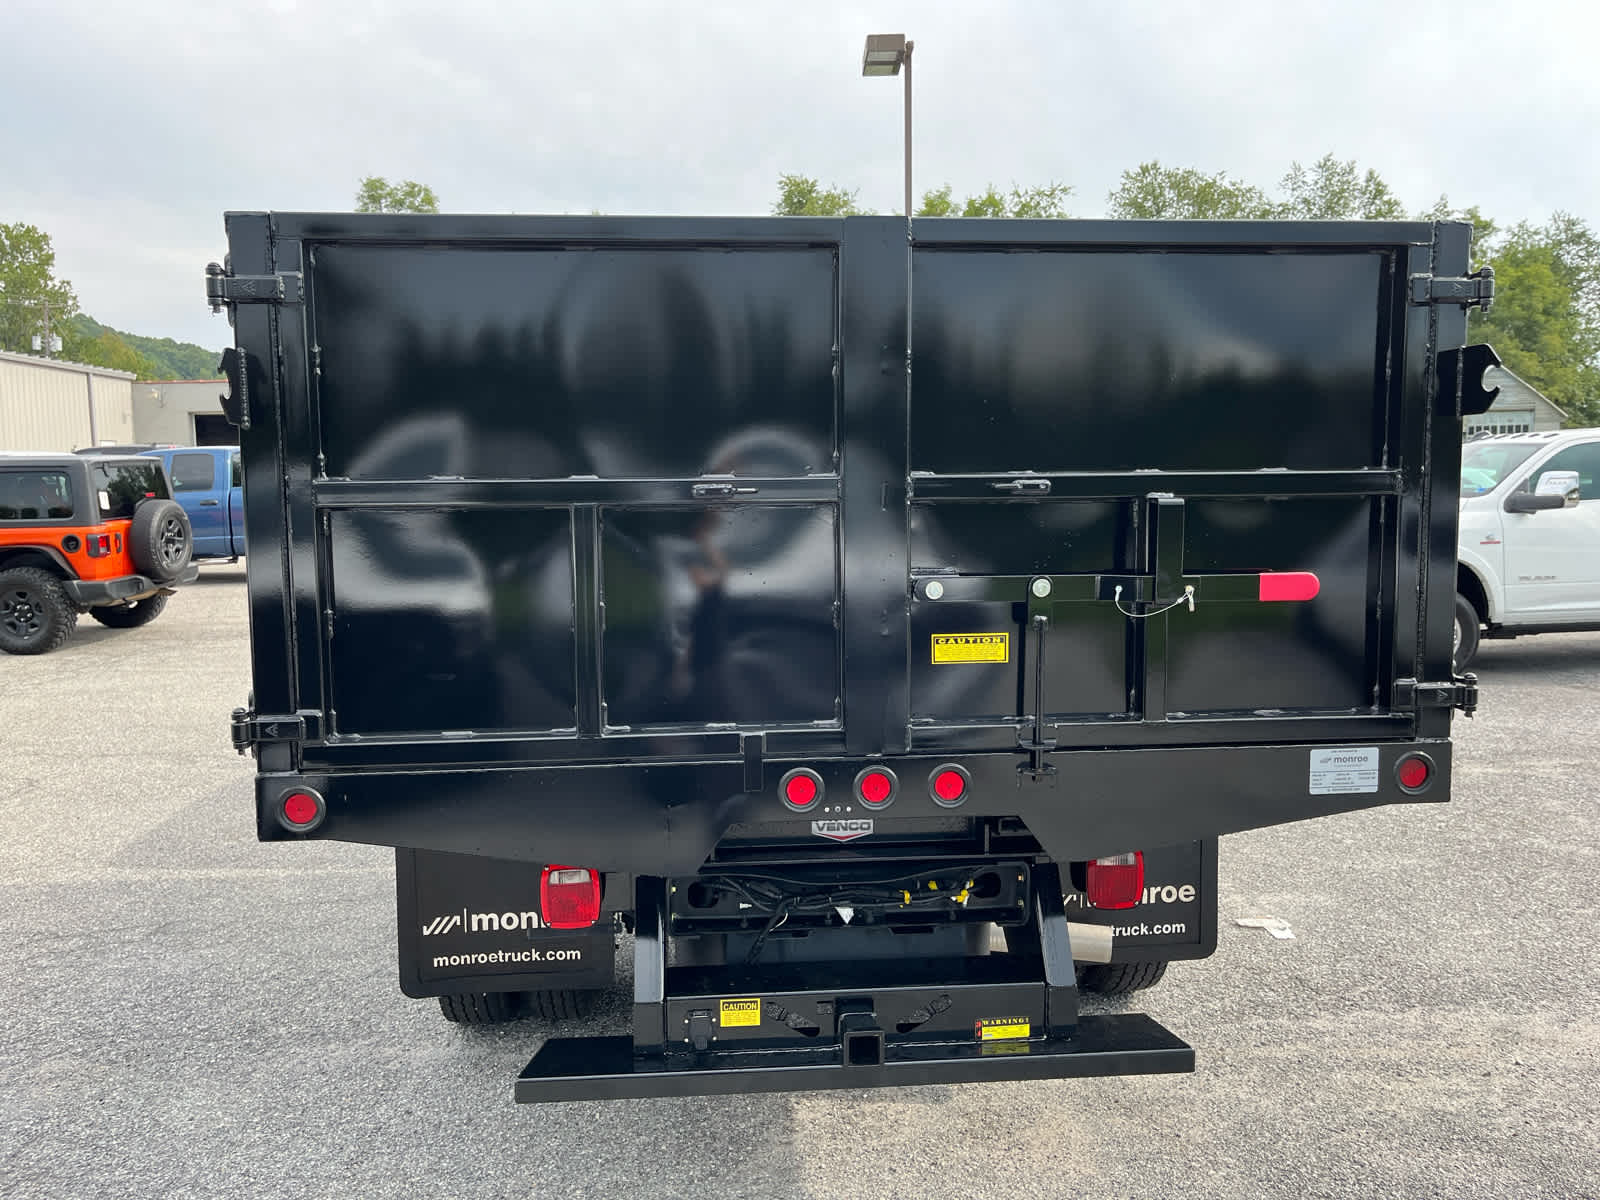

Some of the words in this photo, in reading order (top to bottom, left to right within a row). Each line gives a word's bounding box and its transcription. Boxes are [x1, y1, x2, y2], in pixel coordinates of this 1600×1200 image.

[937, 636, 1002, 644] CAUTION
[816, 821, 871, 832] VENCO
[1142, 885, 1195, 904] roe
[471, 910, 546, 932] mon
[1111, 923, 1185, 936] truck.com
[433, 949, 581, 967] monroetruck.com
[723, 1001, 757, 1011] CAUTION
